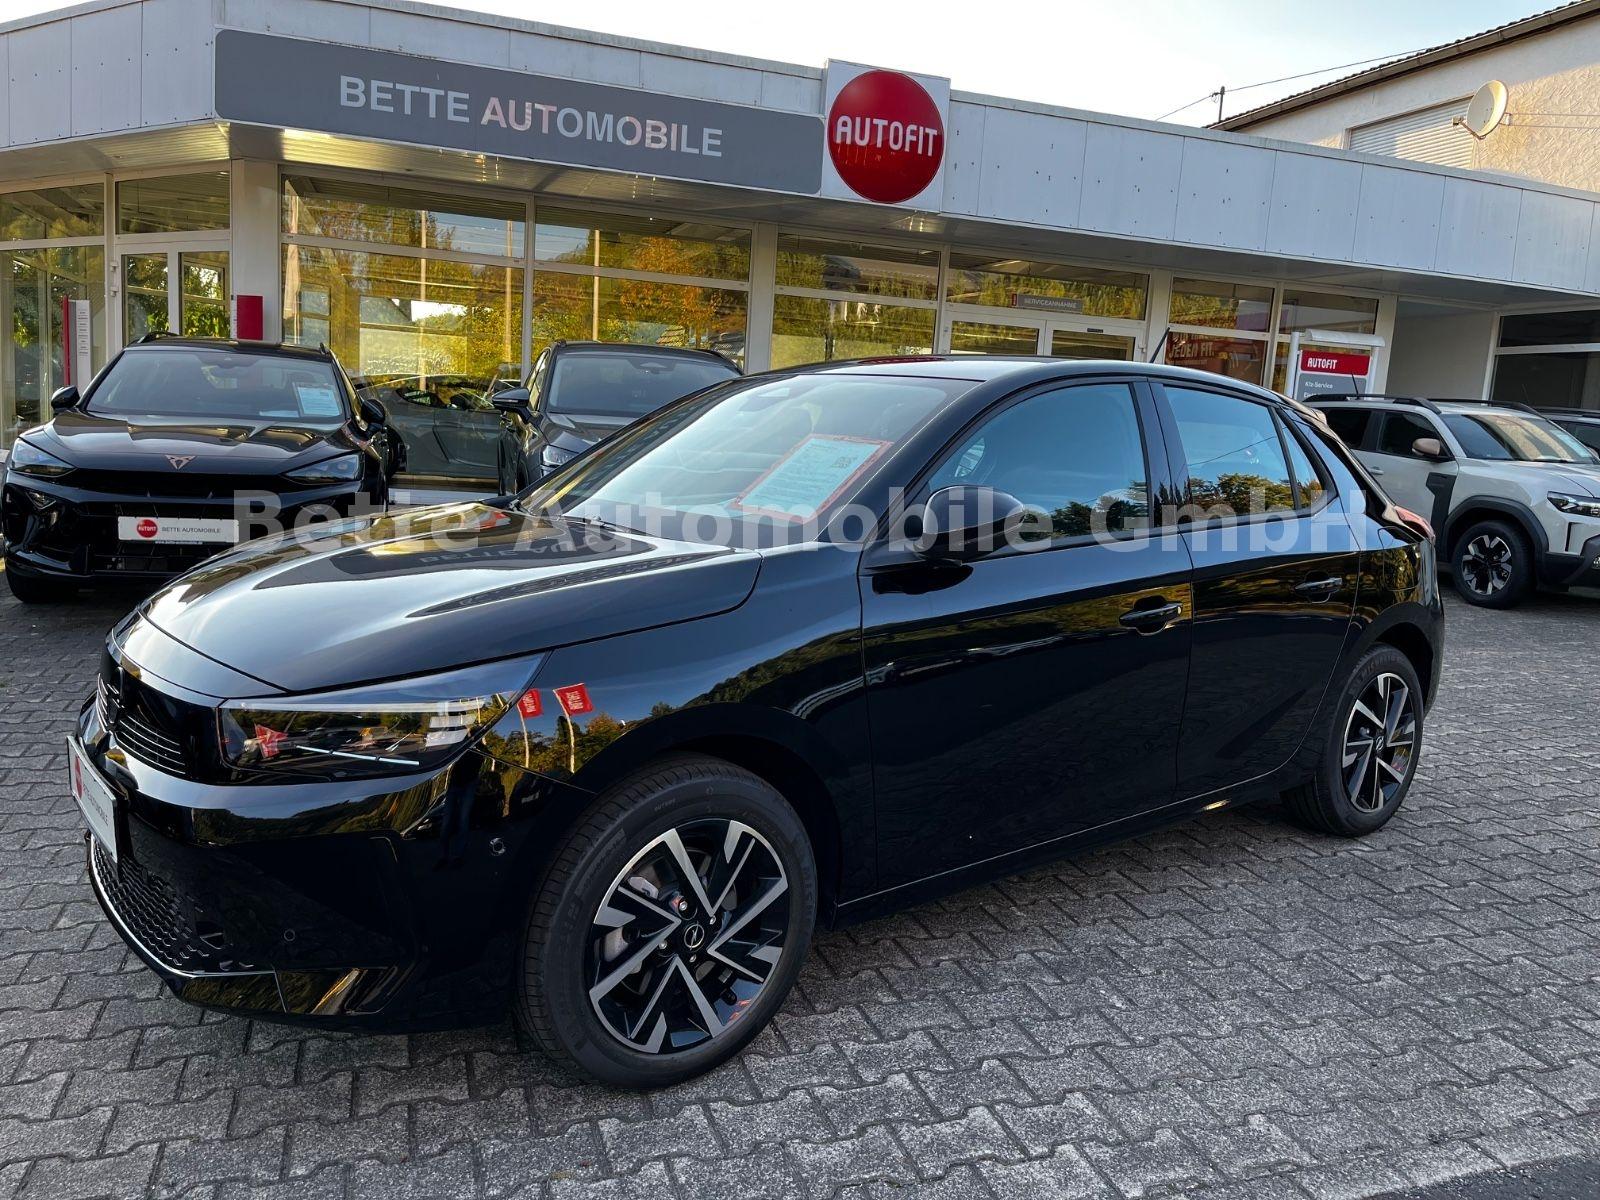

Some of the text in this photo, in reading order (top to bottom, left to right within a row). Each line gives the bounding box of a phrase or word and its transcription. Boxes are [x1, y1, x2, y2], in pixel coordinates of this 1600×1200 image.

[340, 75, 723, 157] BETTE AUTOMOBILE
[836, 115, 938, 157] AUTOFIT
[1024, 297, 1077, 309] SERVICEANNAHME
[1307, 357, 1338, 369] AUTOFIT
